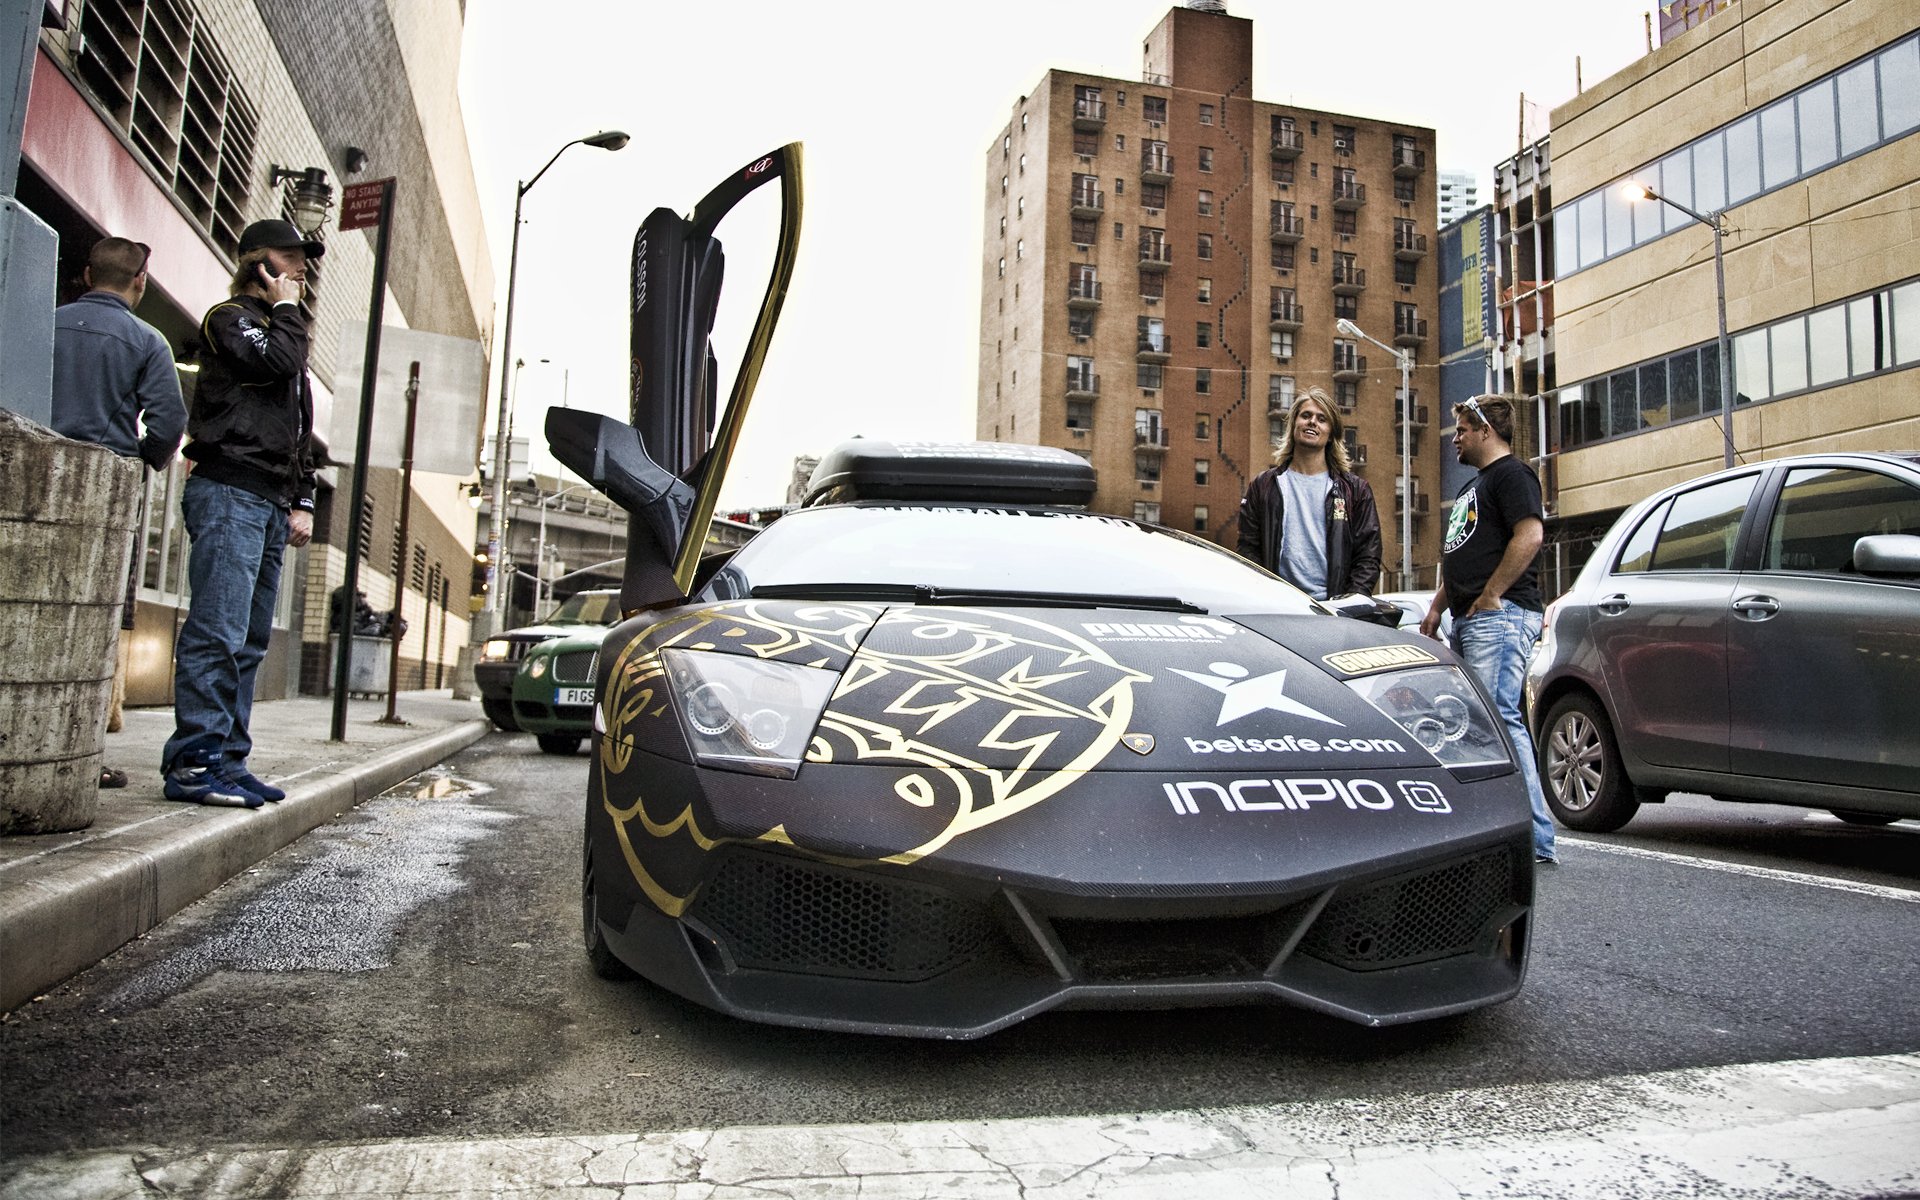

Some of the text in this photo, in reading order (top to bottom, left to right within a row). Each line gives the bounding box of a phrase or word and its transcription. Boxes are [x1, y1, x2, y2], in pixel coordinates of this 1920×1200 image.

[346, 184, 383, 199] NO STANDI
[350, 197, 381, 210] ANYTIM
[637, 240, 648, 312] OLSSON
[1081, 622, 1213, 638] PUMA
[1183, 735, 1407, 754] betsafe.com
[1162, 779, 1395, 815] INCIPIO
